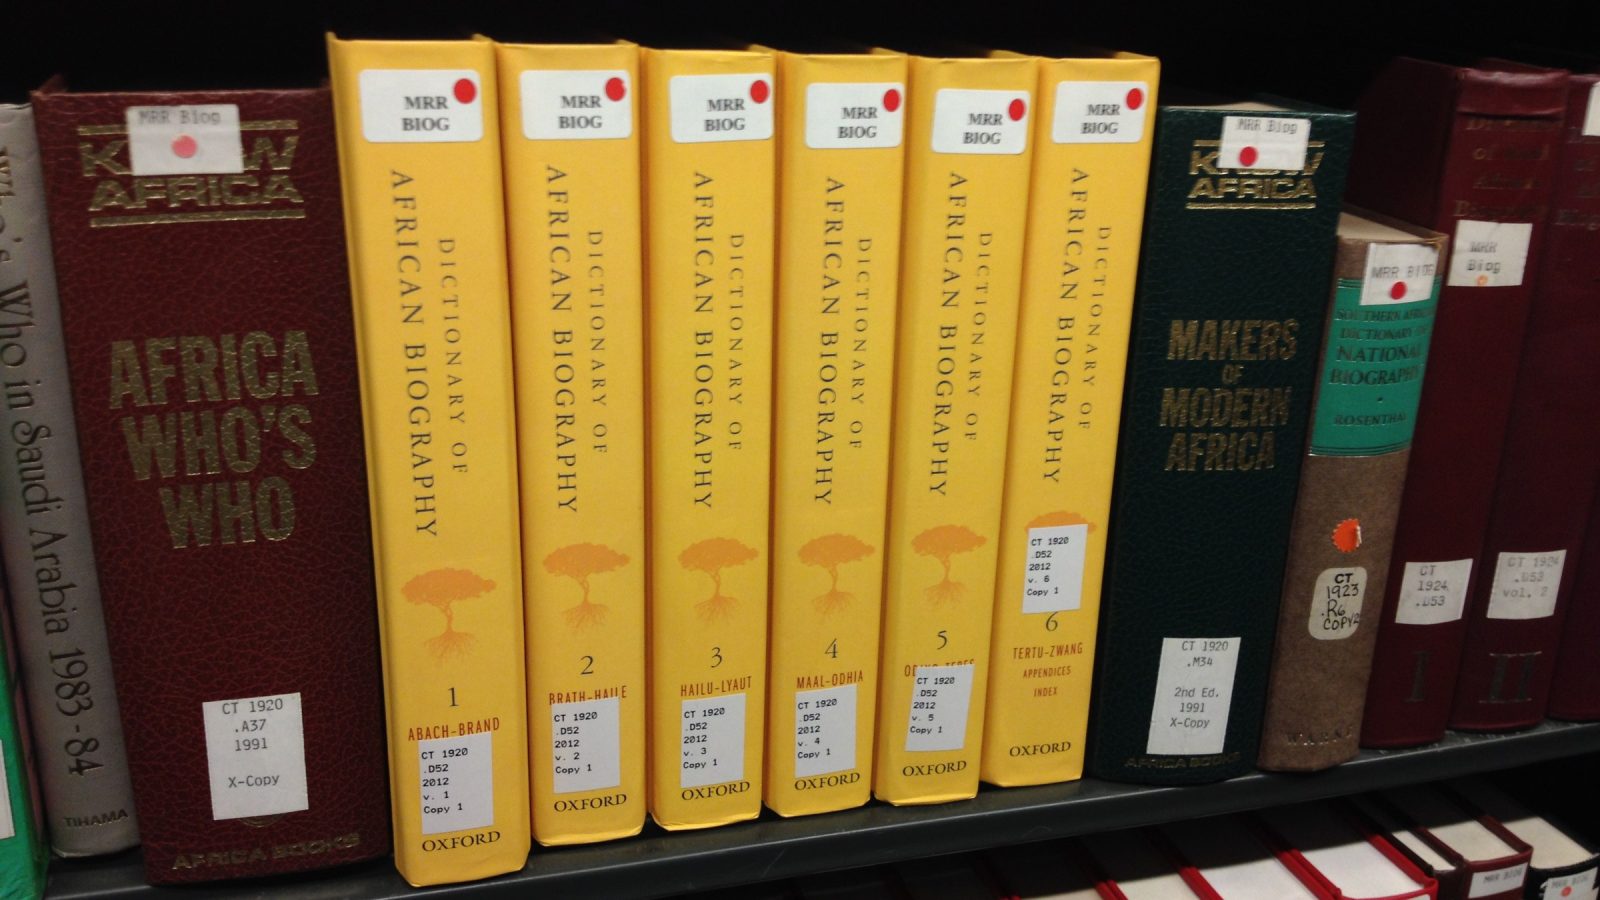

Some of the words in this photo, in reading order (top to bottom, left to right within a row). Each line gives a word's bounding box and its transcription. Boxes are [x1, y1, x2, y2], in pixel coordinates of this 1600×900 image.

[404, 96, 448, 110] MRR
[561, 95, 601, 109] MRR
[707, 98, 746, 112] MRR
[1086, 104, 1120, 115] MRR
[139, 109, 170, 124] MRR
[841, 107, 878, 119] MRR
[968, 113, 1003, 126] MRR
[402, 117, 450, 131] BIOG
[558, 115, 602, 129] BIOG
[704, 118, 746, 132] BIOG
[1081, 122, 1119, 134] BIOG
[1237, 118, 1261, 131] MRR
[837, 126, 877, 138] BIOG
[963, 132, 1002, 144] BIOG
[88, 175, 304, 211] AFRICA
[1187, 178, 1317, 199] AFRICA
[546, 165, 572, 311] AFRICAN
[694, 172, 714, 313] AFRICAN
[941, 171, 968, 307] AFRICAN
[1060, 168, 1089, 300] AFRICAN
[390, 169, 424, 324] AFRICAN
[821, 177, 845, 314] AFRICAN
[1371, 266, 1399, 279] MRR
[968, 233, 992, 396] DICTIONARY
[1082, 227, 1111, 386] DICTIONARY
[0, 280, 34, 368] Who
[588, 231, 607, 406] DICTIONARY
[729, 234, 745, 404] DICTIONARY
[851, 238, 872, 404] DICTIONARY
[1167, 318, 1299, 360] MAKERS
[438, 239, 466, 424] DICTIONARY
[452, 442, 468, 473] OF
[109, 330, 319, 409] AFRICA
[1222, 364, 1244, 384] OF
[5, 379, 41, 410] in
[1043, 316, 1075, 483] BIOGRAPHY
[930, 325, 957, 496] BIOGRAPHY
[1160, 387, 1293, 427] MODERN
[553, 329, 577, 513] BIOGRAPHY
[694, 331, 714, 508] BIOGRAPHY
[814, 332, 839, 505] BIOGRAPHY
[1078, 402, 1092, 430] OF
[849, 420, 863, 449] OF
[965, 413, 978, 441] OF
[120, 405, 318, 481] WHO'S
[404, 343, 437, 536] BIOGRAPHY
[593, 423, 607, 454] OF
[728, 422, 743, 450] OF
[1164, 431, 1275, 471] AFRICA
[12, 420, 64, 516] Saudi
[160, 476, 296, 549] WHO
[1031, 538, 1043, 546] CT
[1048, 536, 1069, 545] 1920
[1420, 565, 1436, 576] CT
[1507, 557, 1525, 568] CT
[29, 527, 78, 636] Arabia
[1334, 573, 1354, 584] CT
[1417, 581, 1447, 591] 1924
[1027, 588, 1048, 597] Copy
[1327, 584, 1359, 599] 1923
[1503, 588, 1531, 599] vol.
[1541, 586, 1548, 597] 2
[1045, 611, 1058, 632] 6
[825, 638, 838, 659] 4
[936, 630, 948, 650] 5
[1182, 641, 1194, 651] CT
[1202, 641, 1229, 651] 1920
[711, 647, 723, 668] 3
[1013, 642, 1083, 660] TERTU-ZWANG
[580, 656, 594, 675] 2
[1187, 657, 1213, 667] .M34
[797, 670, 863, 689] MAAL-ODHIA
[1023, 665, 1071, 679] APPENDICES
[680, 676, 752, 697] HAILU-LYAUT
[934, 677, 955, 685] 1920
[448, 687, 459, 707] 1
[1034, 687, 1057, 697] INDEX
[1174, 687, 1195, 697] 2nd
[1201, 687, 1219, 698] Ed.
[222, 703, 239, 715] CT
[249, 698, 283, 713] 1920
[684, 710, 696, 719] CT
[702, 707, 725, 717] 1920
[798, 702, 809, 710] CT
[815, 699, 837, 708] 1920
[913, 702, 936, 710] 2012
[1179, 703, 1205, 713] 1991
[554, 714, 566, 722] CT
[573, 711, 598, 721] 1920
[1170, 718, 1210, 729] X-Copy
[234, 719, 267, 733] .A37
[408, 717, 500, 741] ABACH-BRAND
[798, 726, 820, 734] 2012
[910, 726, 932, 735] Copy
[938, 726, 942, 734] 1
[235, 738, 268, 751] 1991
[554, 740, 579, 748] 2012
[684, 735, 707, 744] 2012
[814, 737, 820, 745] 4
[421, 751, 434, 760] CT
[443, 748, 468, 758] 1920
[573, 752, 580, 760] 2
[798, 751, 820, 760] Copy
[1009, 742, 1071, 757] OXFORD
[555, 765, 580, 775] Copy
[587, 764, 592, 772] 1
[683, 761, 706, 769] Copy
[713, 759, 718, 767] 1
[902, 760, 967, 777] OXFORD
[228, 774, 279, 788] X-Copy
[422, 778, 449, 787] 2012
[794, 772, 860, 791] OXFORD
[444, 791, 449, 799] 1
[681, 781, 750, 801] OXFORD
[424, 805, 450, 814] Copy
[457, 803, 463, 811] 1
[554, 793, 627, 813] OXFORD
[64, 809, 128, 827] TIHAMA
[422, 831, 500, 852] OXFORD
[171, 848, 268, 870] AFRICA
